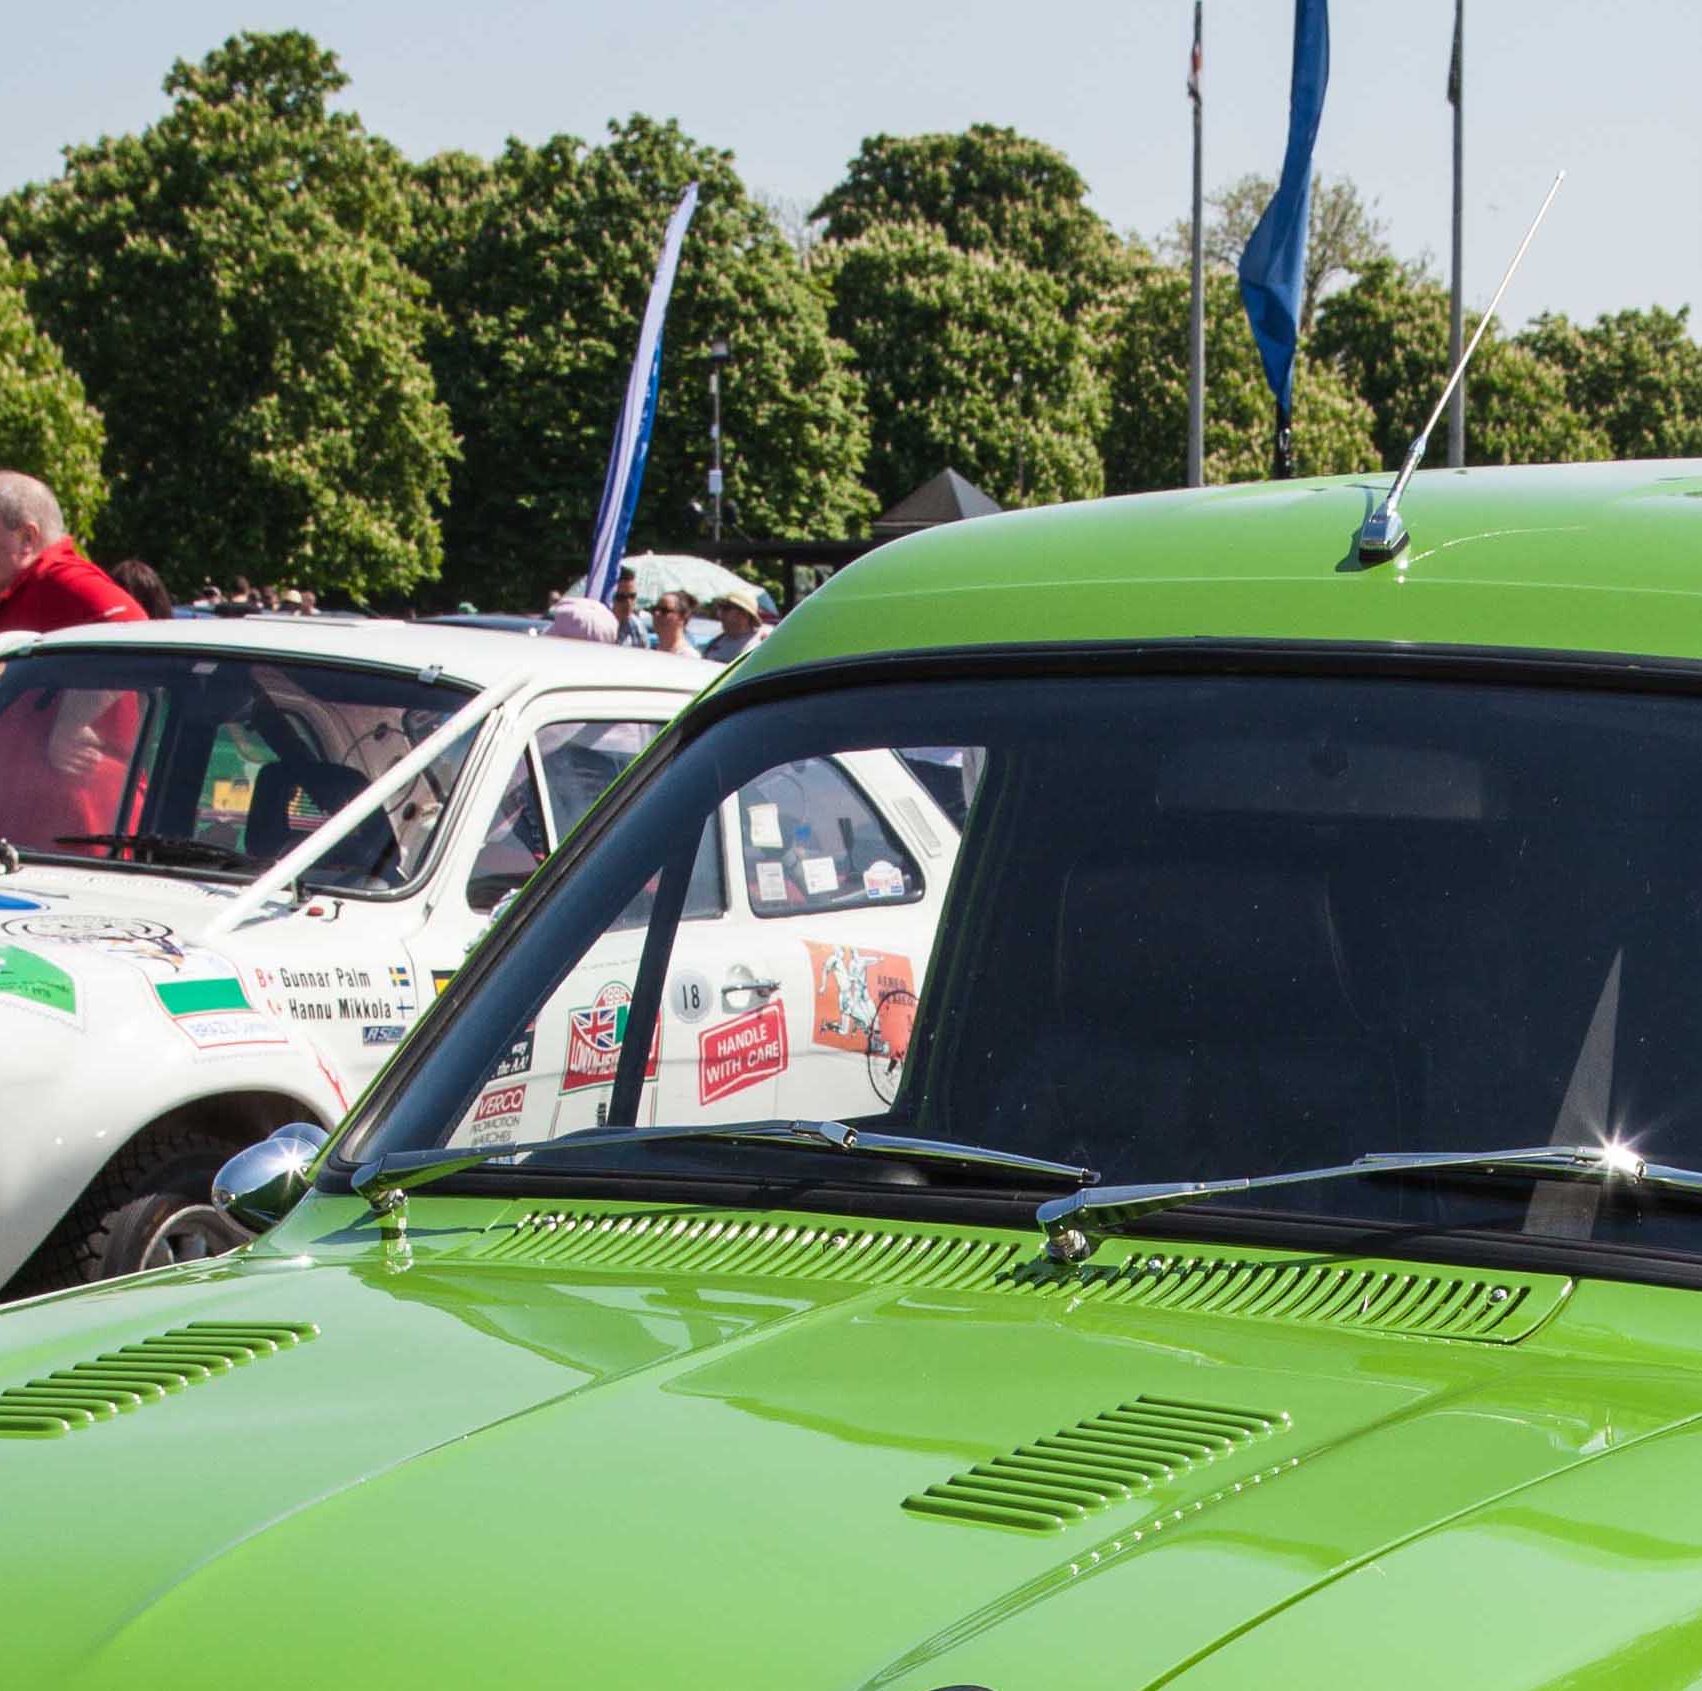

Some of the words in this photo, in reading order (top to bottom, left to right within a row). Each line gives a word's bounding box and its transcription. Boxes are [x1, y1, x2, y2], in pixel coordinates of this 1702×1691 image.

[281, 967, 332, 989] Gunnar
[338, 967, 371, 988] Palm
[288, 998, 332, 1020] Hannu
[339, 998, 391, 1020] Mikkola
[682, 983, 701, 1011] 18
[717, 1023, 768, 1057] HANDLE
[706, 1057, 742, 1084] WITH
[746, 1041, 779, 1068] CARE
[479, 1089, 524, 1118] VERCO
